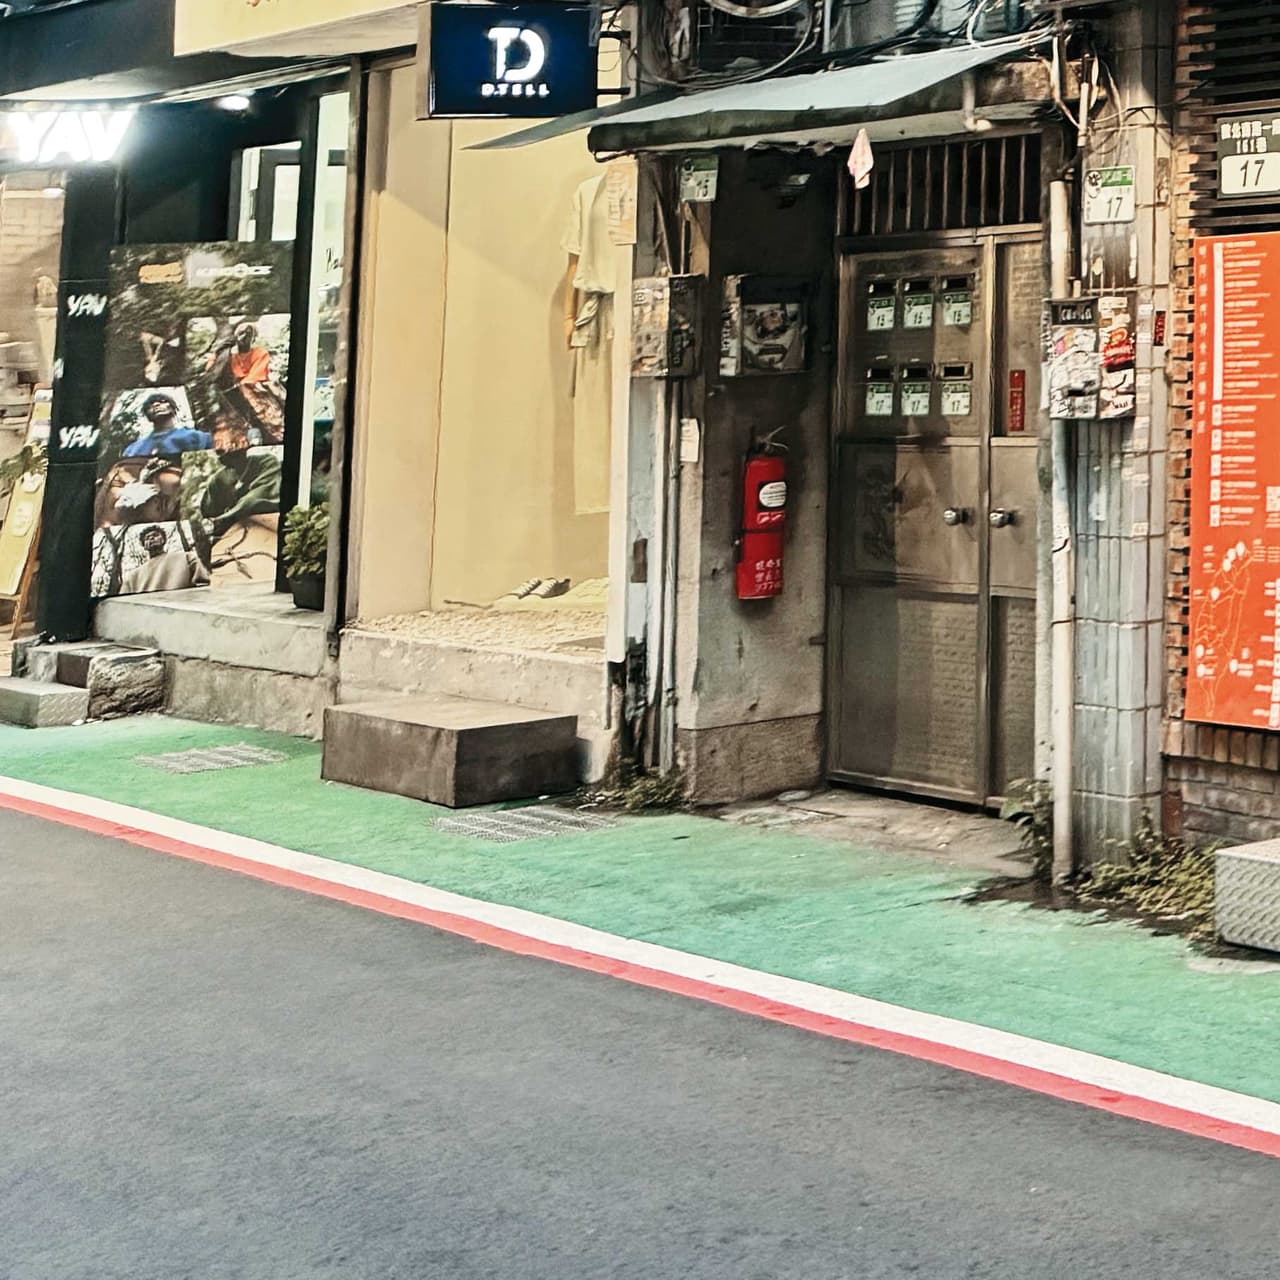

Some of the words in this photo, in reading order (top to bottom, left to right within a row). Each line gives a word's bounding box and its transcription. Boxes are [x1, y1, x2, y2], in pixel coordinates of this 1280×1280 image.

[480, 82, 551, 97] D.TELL
[1239, 159, 1265, 187] 17
[1106, 196, 1123, 218] 17
